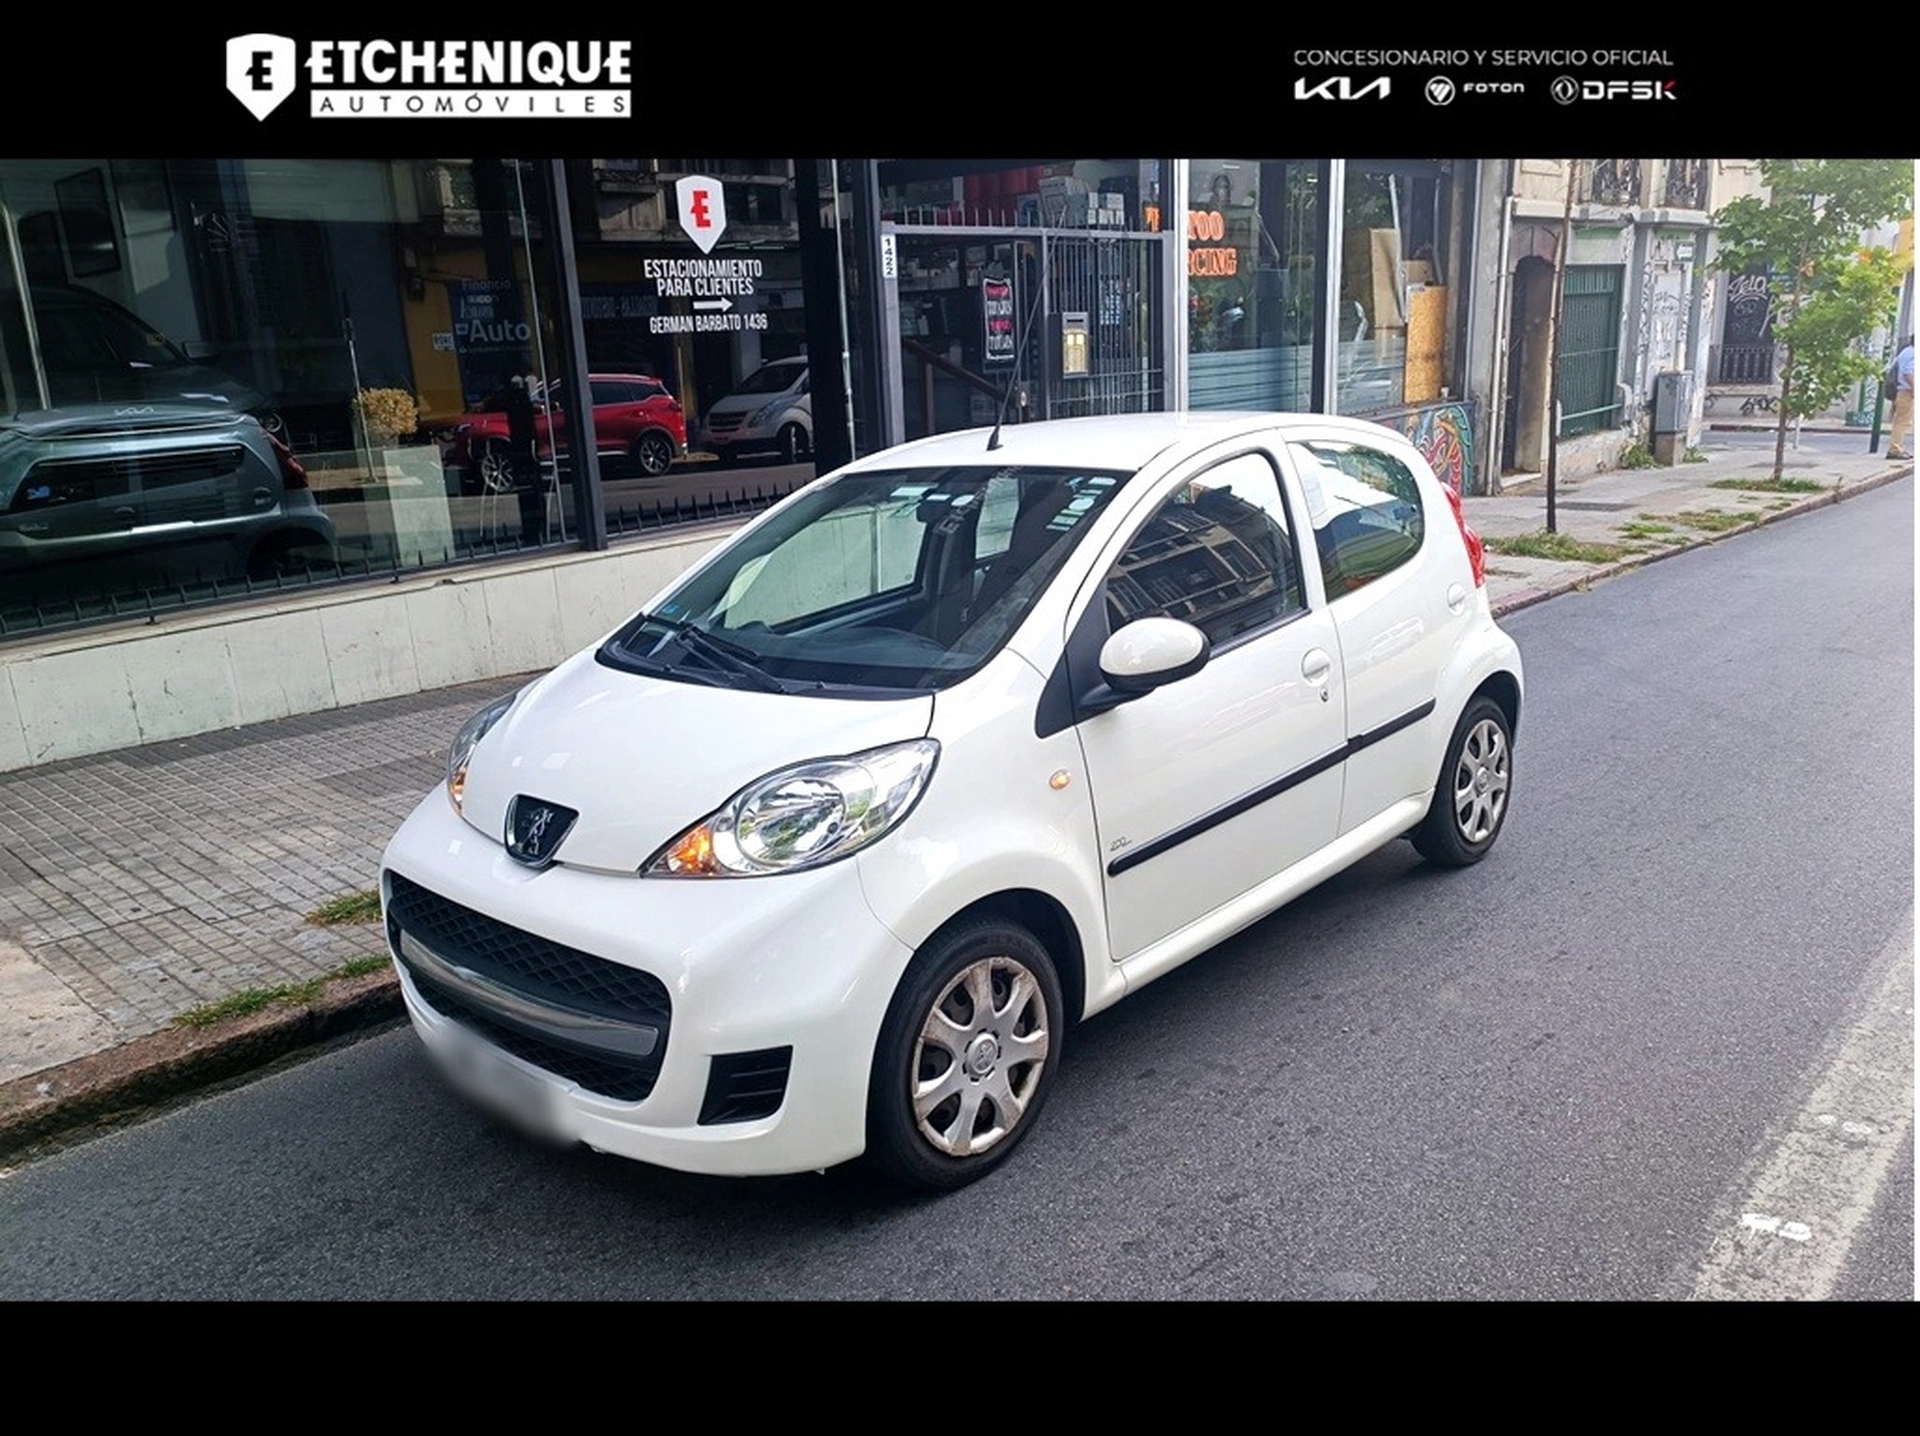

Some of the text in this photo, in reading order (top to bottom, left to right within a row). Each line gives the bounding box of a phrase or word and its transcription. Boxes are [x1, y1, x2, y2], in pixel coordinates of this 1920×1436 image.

[884, 238, 893, 275] 1422
[643, 259, 762, 278] ESTACIONAMIENTO
[656, 277, 754, 297] PARA CLIENTES
[470, 319, 532, 342] Auto
[649, 313, 768, 334] GERMAN BARBATO 1436
